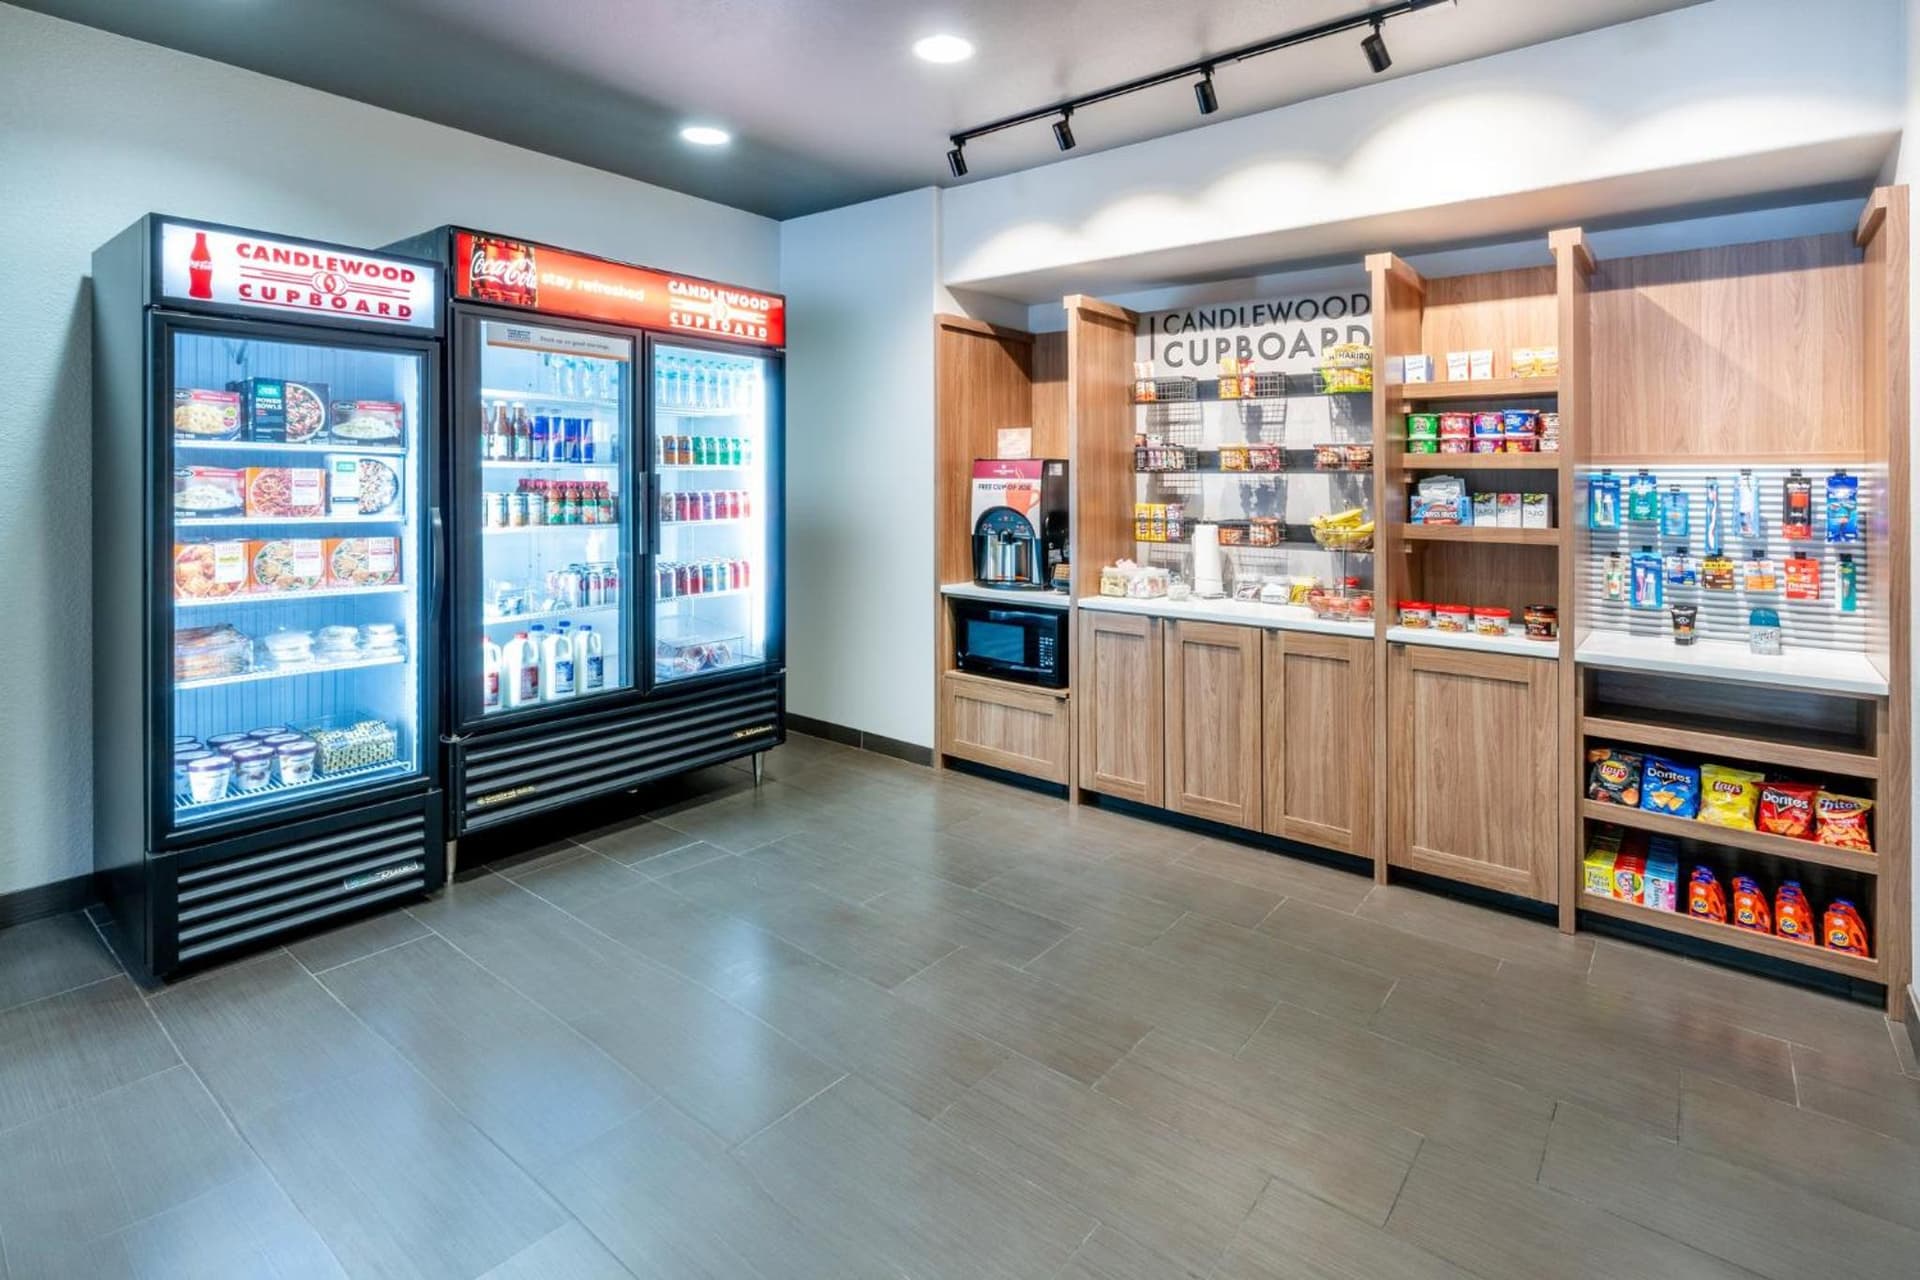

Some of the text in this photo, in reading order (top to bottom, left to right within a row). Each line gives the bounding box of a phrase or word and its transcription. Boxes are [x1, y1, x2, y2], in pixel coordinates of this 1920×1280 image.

[236, 243, 415, 283] CANDLEWOOD
[238, 284, 412, 318] CUPBOARD
[541, 272, 645, 301] stay refreshed
[668, 281, 769, 311] CANDLEWOOD
[670, 311, 768, 338] CUPBOARD
[1163, 293, 1371, 334] CANDLEWOOD
[1163, 324, 1370, 368] CUPBOARD
[978, 483, 992, 491] FREE
[993, 483, 1006, 491] CUP
[1647, 767, 1691, 784] Doritos
[1762, 790, 1809, 809] Doritos
